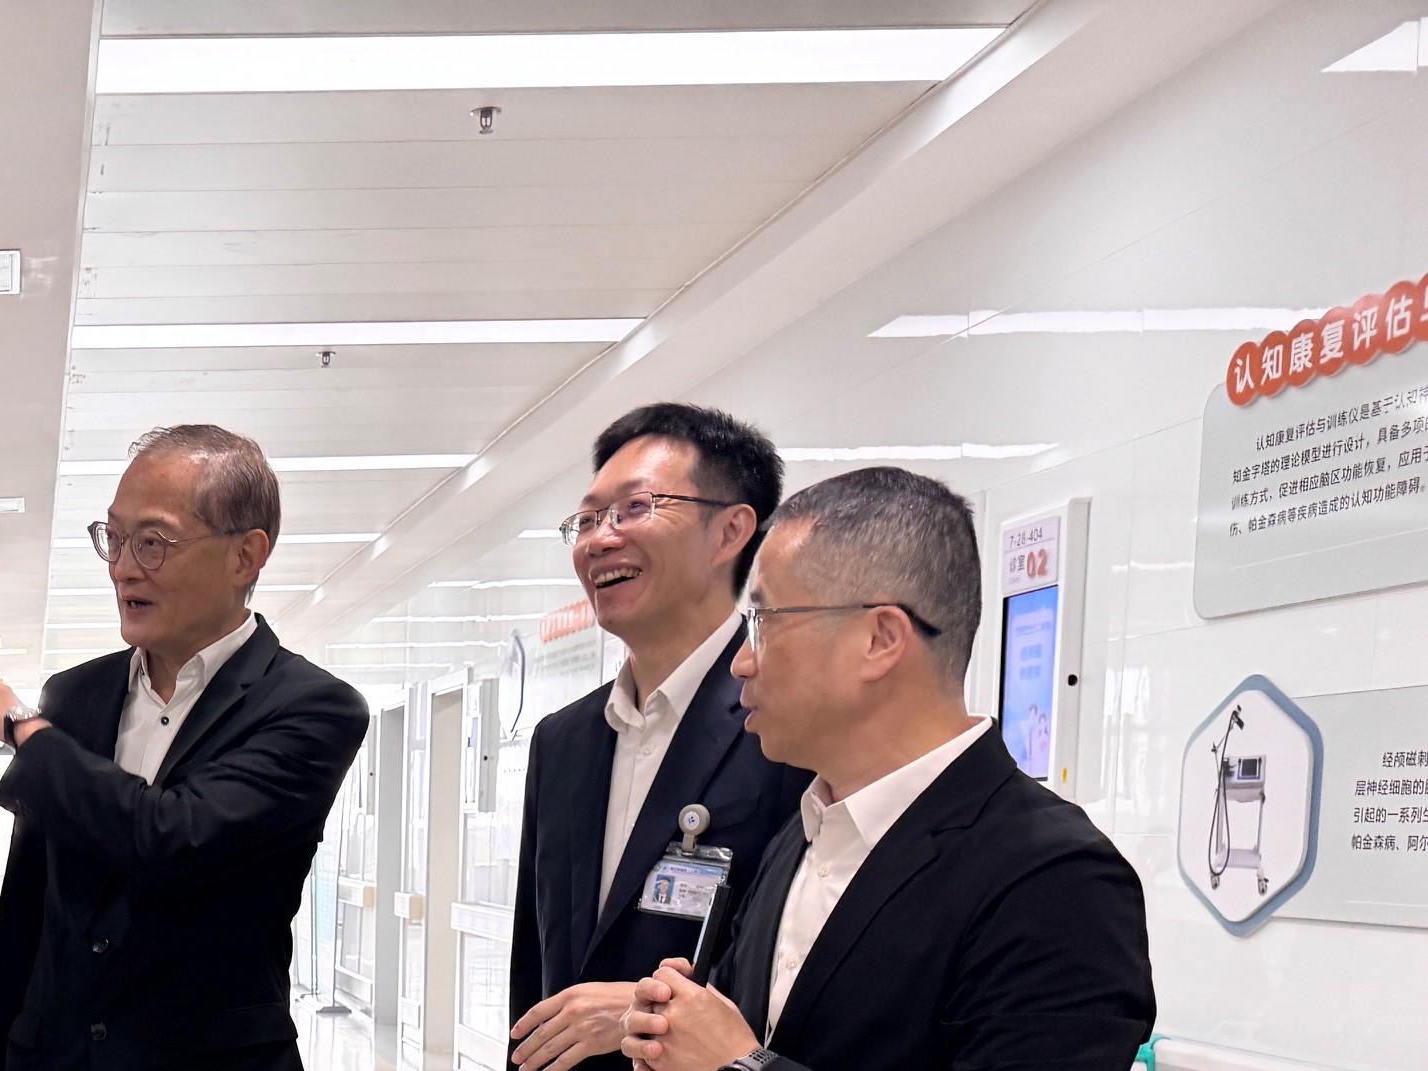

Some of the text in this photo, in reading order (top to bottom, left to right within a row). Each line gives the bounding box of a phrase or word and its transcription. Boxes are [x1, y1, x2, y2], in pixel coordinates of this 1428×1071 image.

[1027, 549, 1049, 580] 02
[1382, 750, 1428, 768] 经颅磁刺
